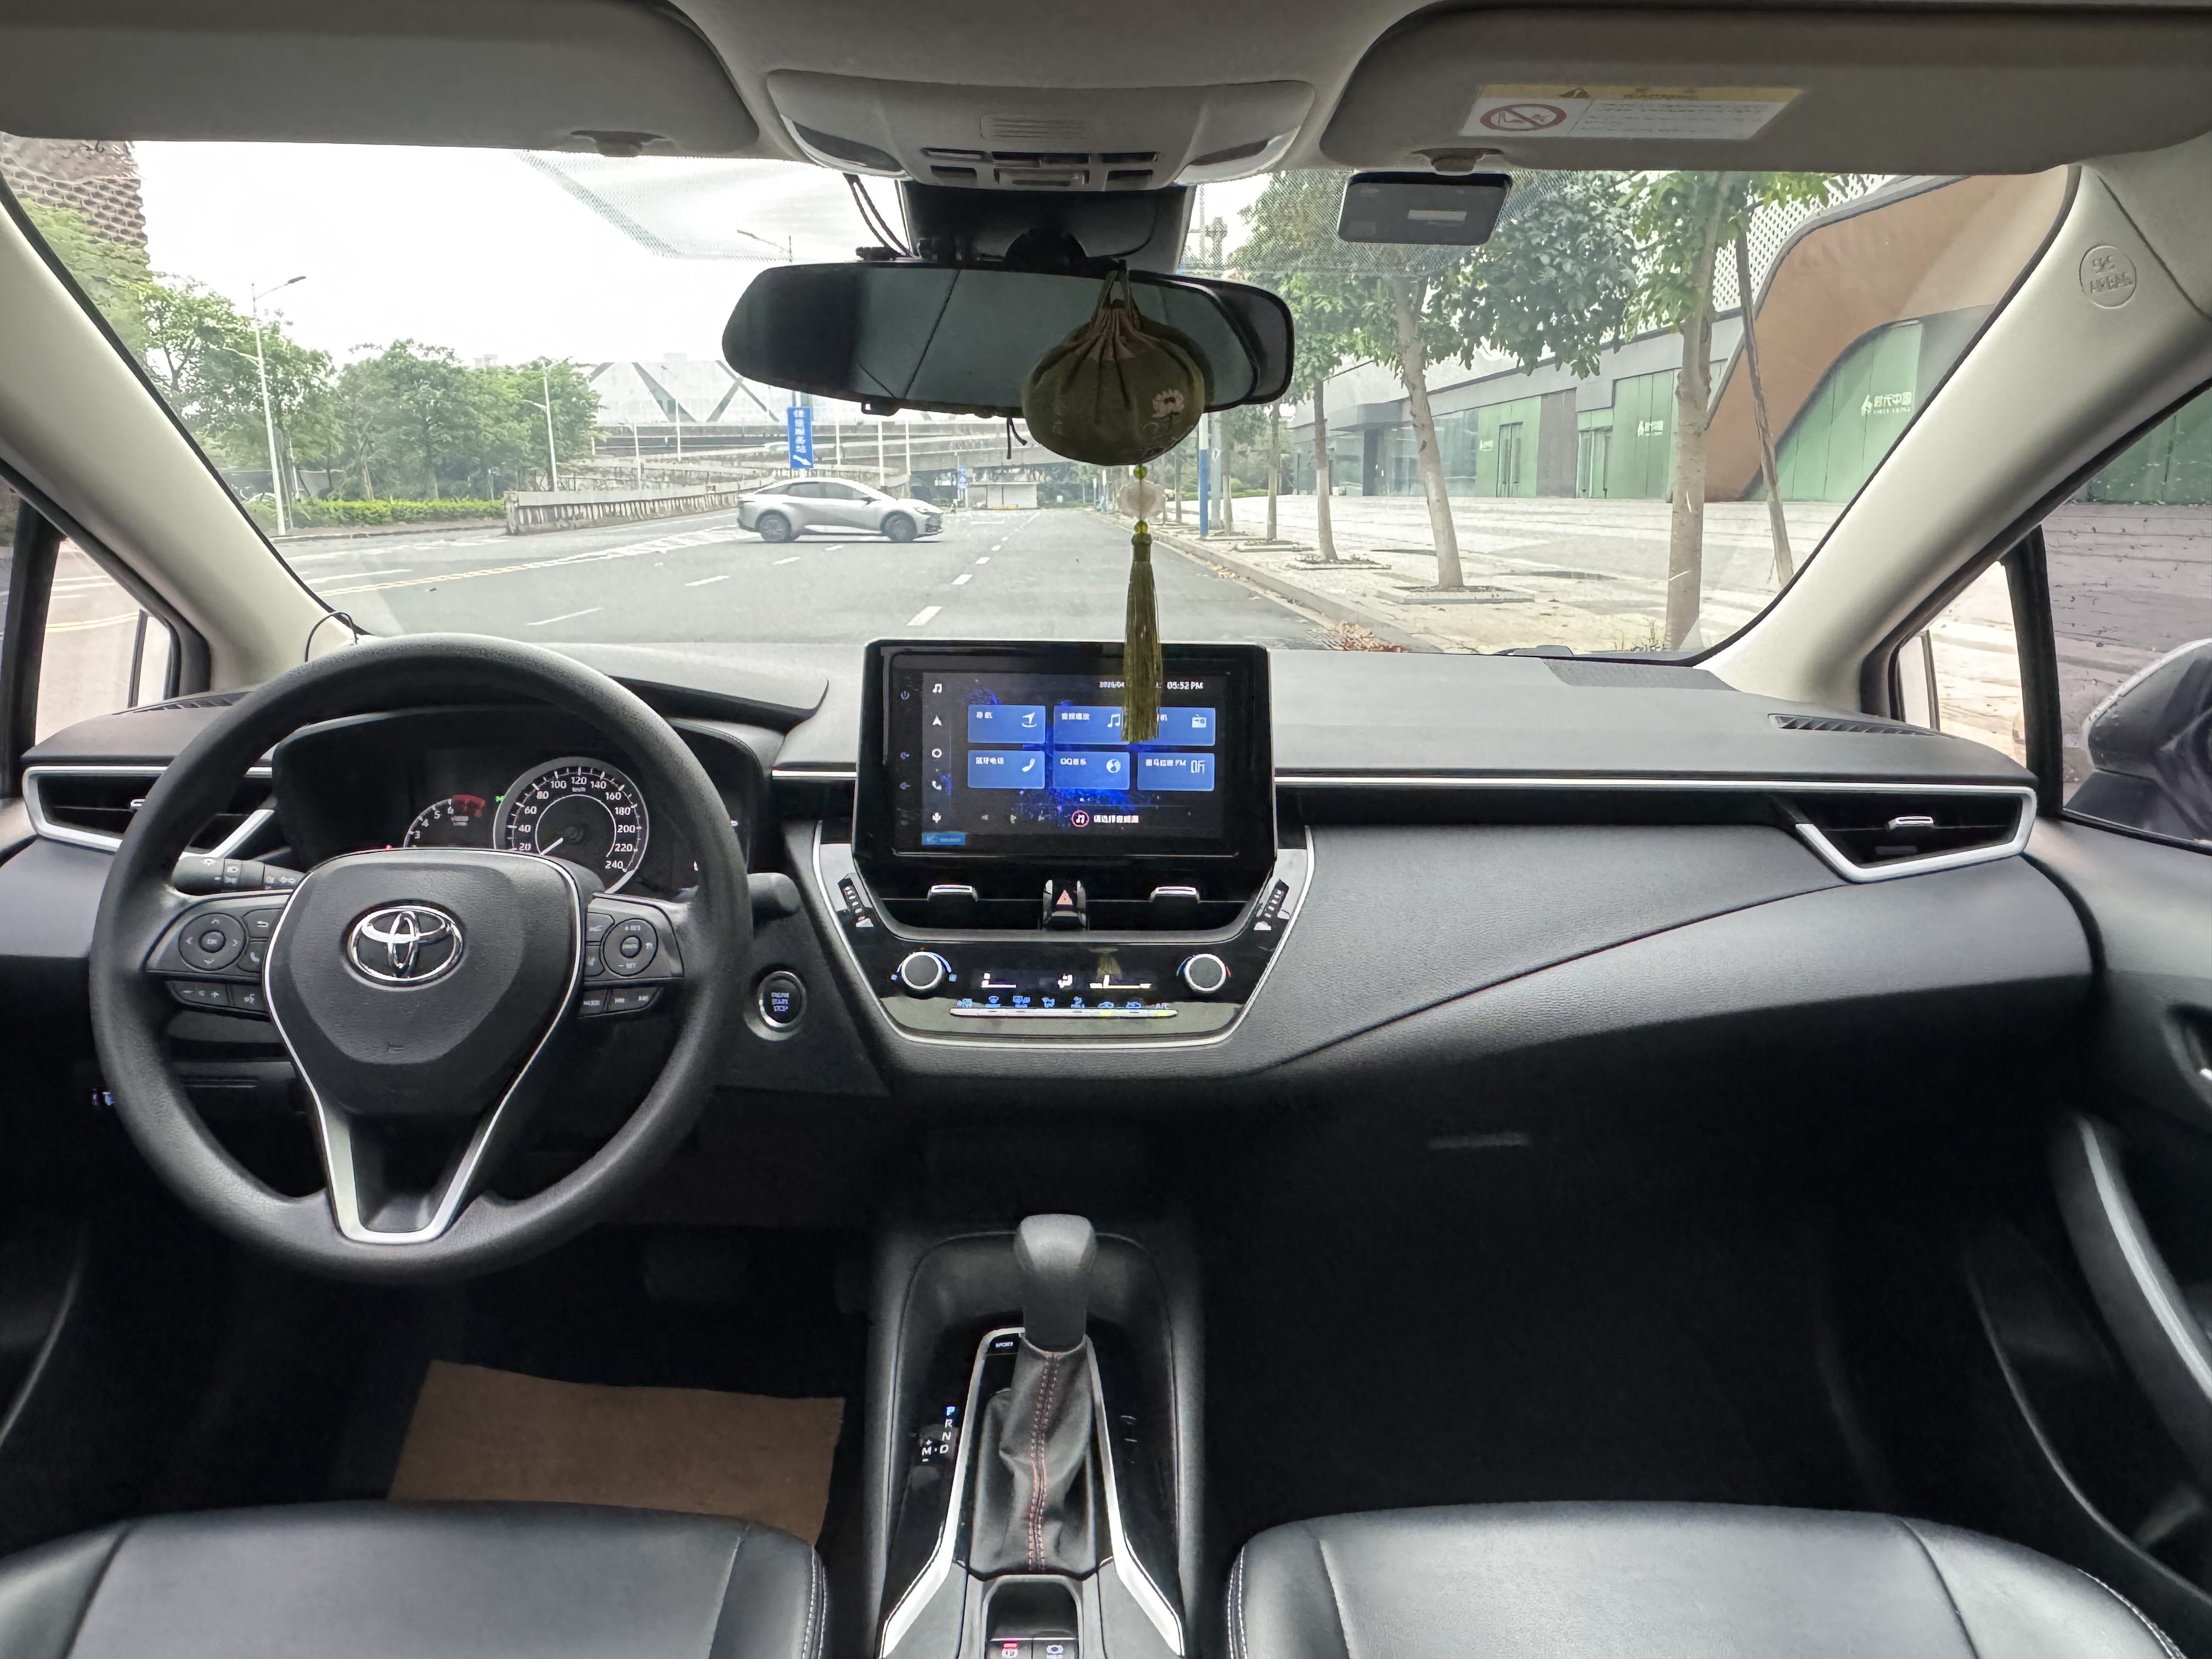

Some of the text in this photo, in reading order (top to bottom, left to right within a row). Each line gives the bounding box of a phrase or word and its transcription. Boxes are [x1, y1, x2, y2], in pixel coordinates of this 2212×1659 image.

[550, 780, 567, 789] 100
[571, 776, 587, 785] 120
[590, 781, 607, 789] 140
[537, 791, 549, 799] 80
[605, 792, 622, 800] 160
[524, 806, 537, 815] 60
[518, 824, 532, 833] 40
[617, 825, 635, 833] 200
[518, 843, 532, 851] 20
[614, 843, 633, 852] 220
[605, 860, 623, 869] 240
[946, 1406, 956, 1416] P
[945, 1419, 953, 1428] R
[941, 1431, 951, 1441] N
[922, 1446, 932, 1455] M
[940, 1444, 949, 1454] D
